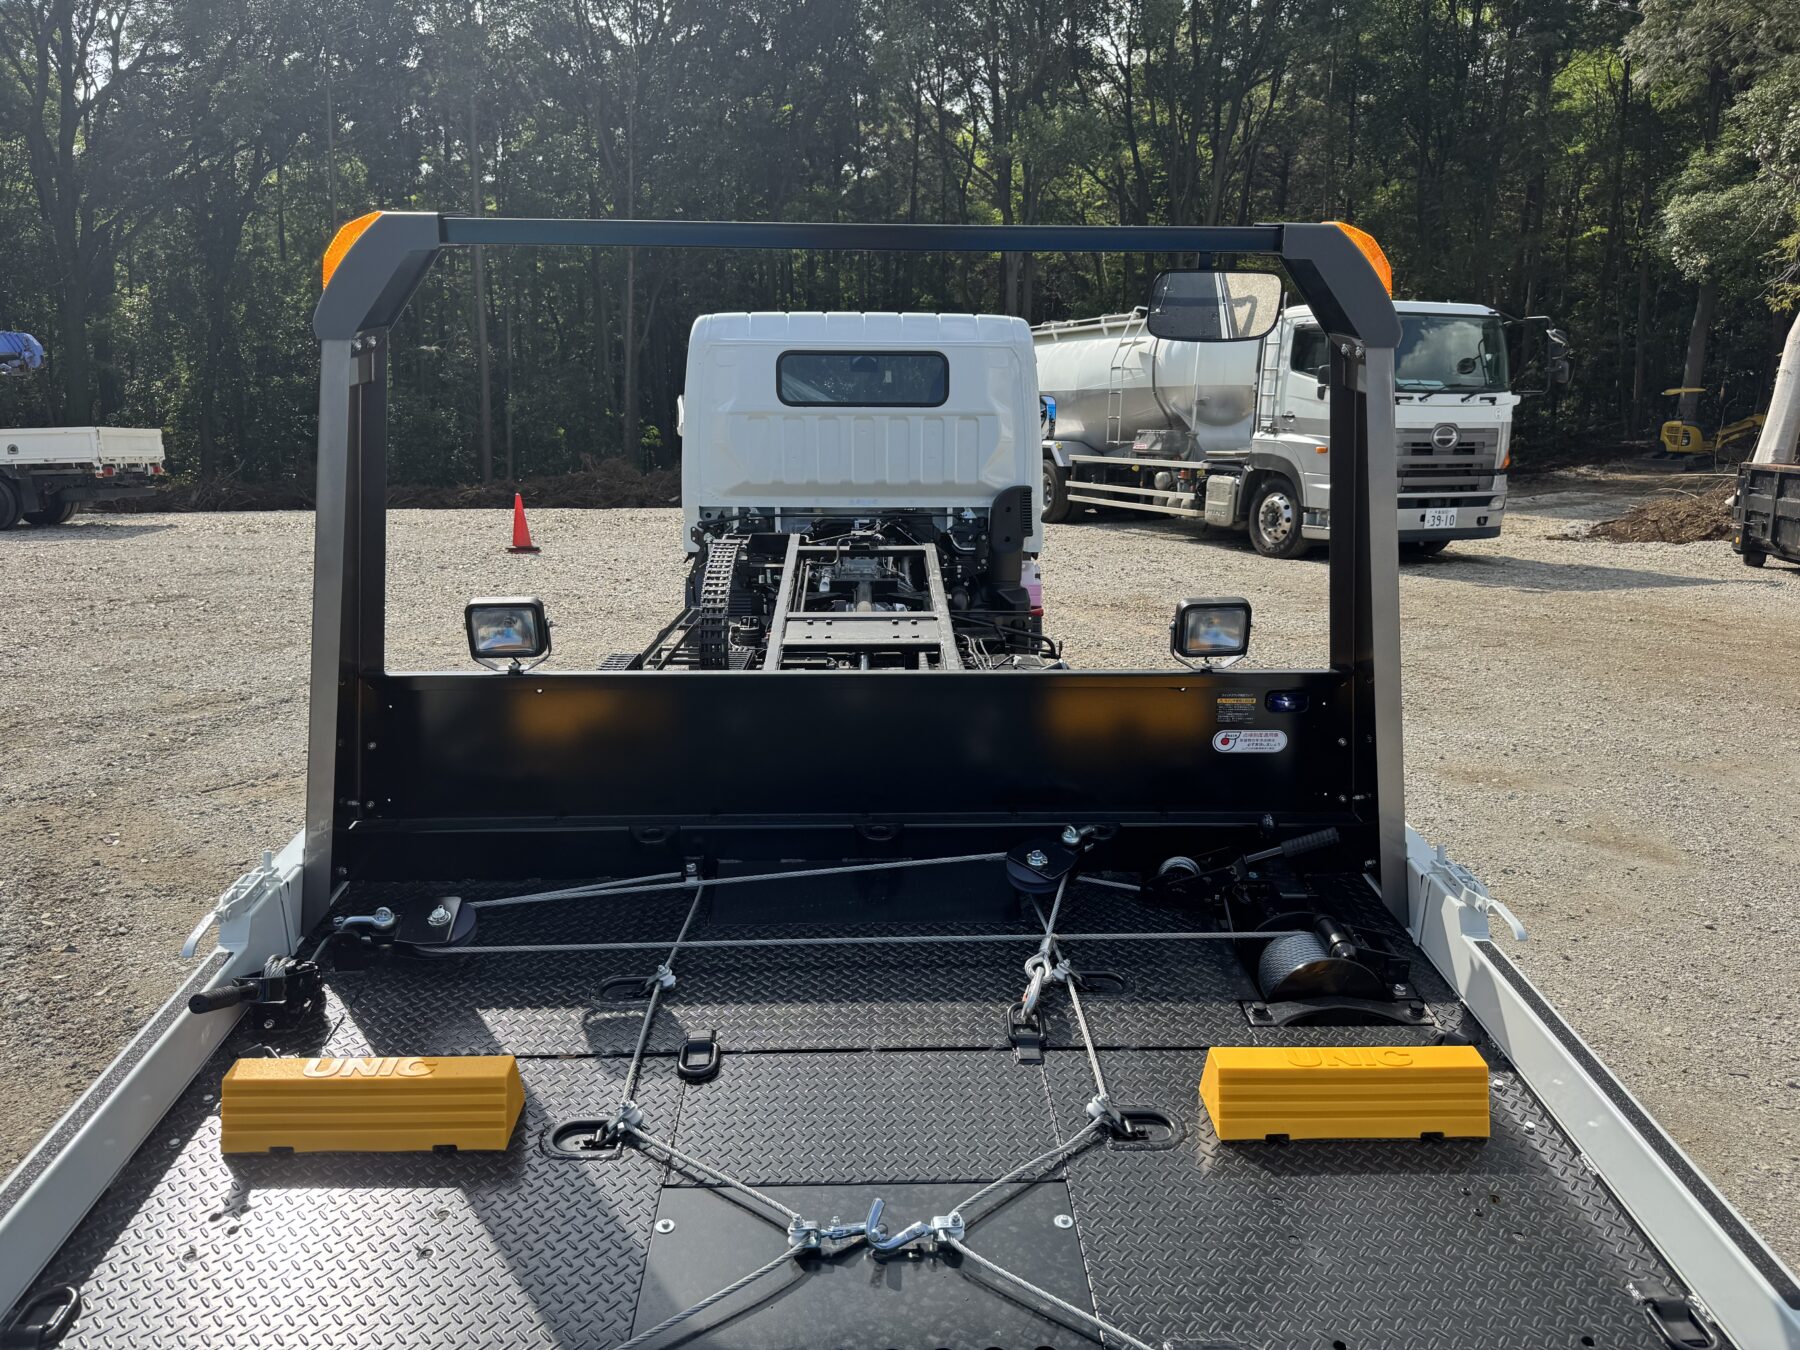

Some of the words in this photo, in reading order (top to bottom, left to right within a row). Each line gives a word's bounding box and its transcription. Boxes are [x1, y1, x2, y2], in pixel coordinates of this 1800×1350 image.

[1430, 514, 1455, 527] 39-10
[302, 1057, 438, 1078] UNIC
[1284, 1048, 1414, 1068] UNIC
